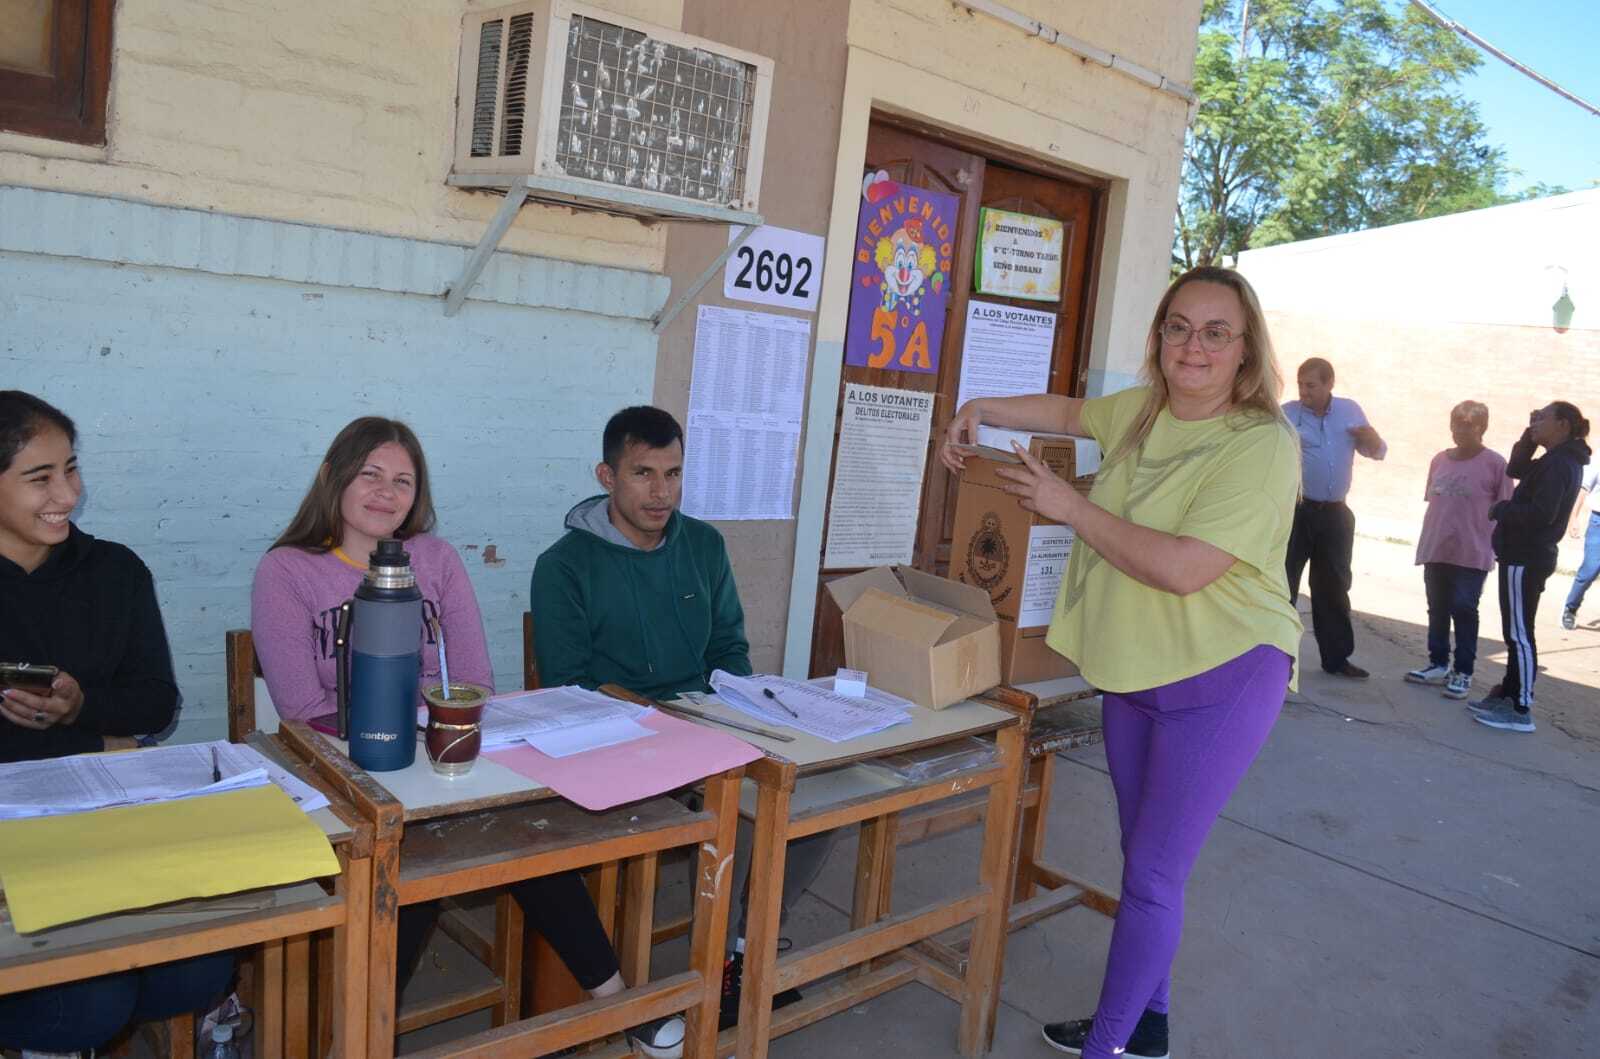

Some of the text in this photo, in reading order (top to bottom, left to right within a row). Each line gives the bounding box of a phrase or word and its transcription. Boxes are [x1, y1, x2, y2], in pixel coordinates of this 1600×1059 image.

[858, 196, 952, 273] BIENVENIDOS
[734, 246, 812, 298] 2692
[973, 307, 980, 316] A
[983, 308, 1002, 318] LOS
[1005, 311, 1053, 324] VOTANTES
[899, 321, 931, 369] A
[848, 390, 856, 400] A
[858, 391, 878, 402] LOS
[881, 393, 929, 408] VOTANTES
[855, 406, 880, 417] DELITOS
[880, 409, 920, 421] ELECTORALES
[360, 732, 398, 742] contigo
